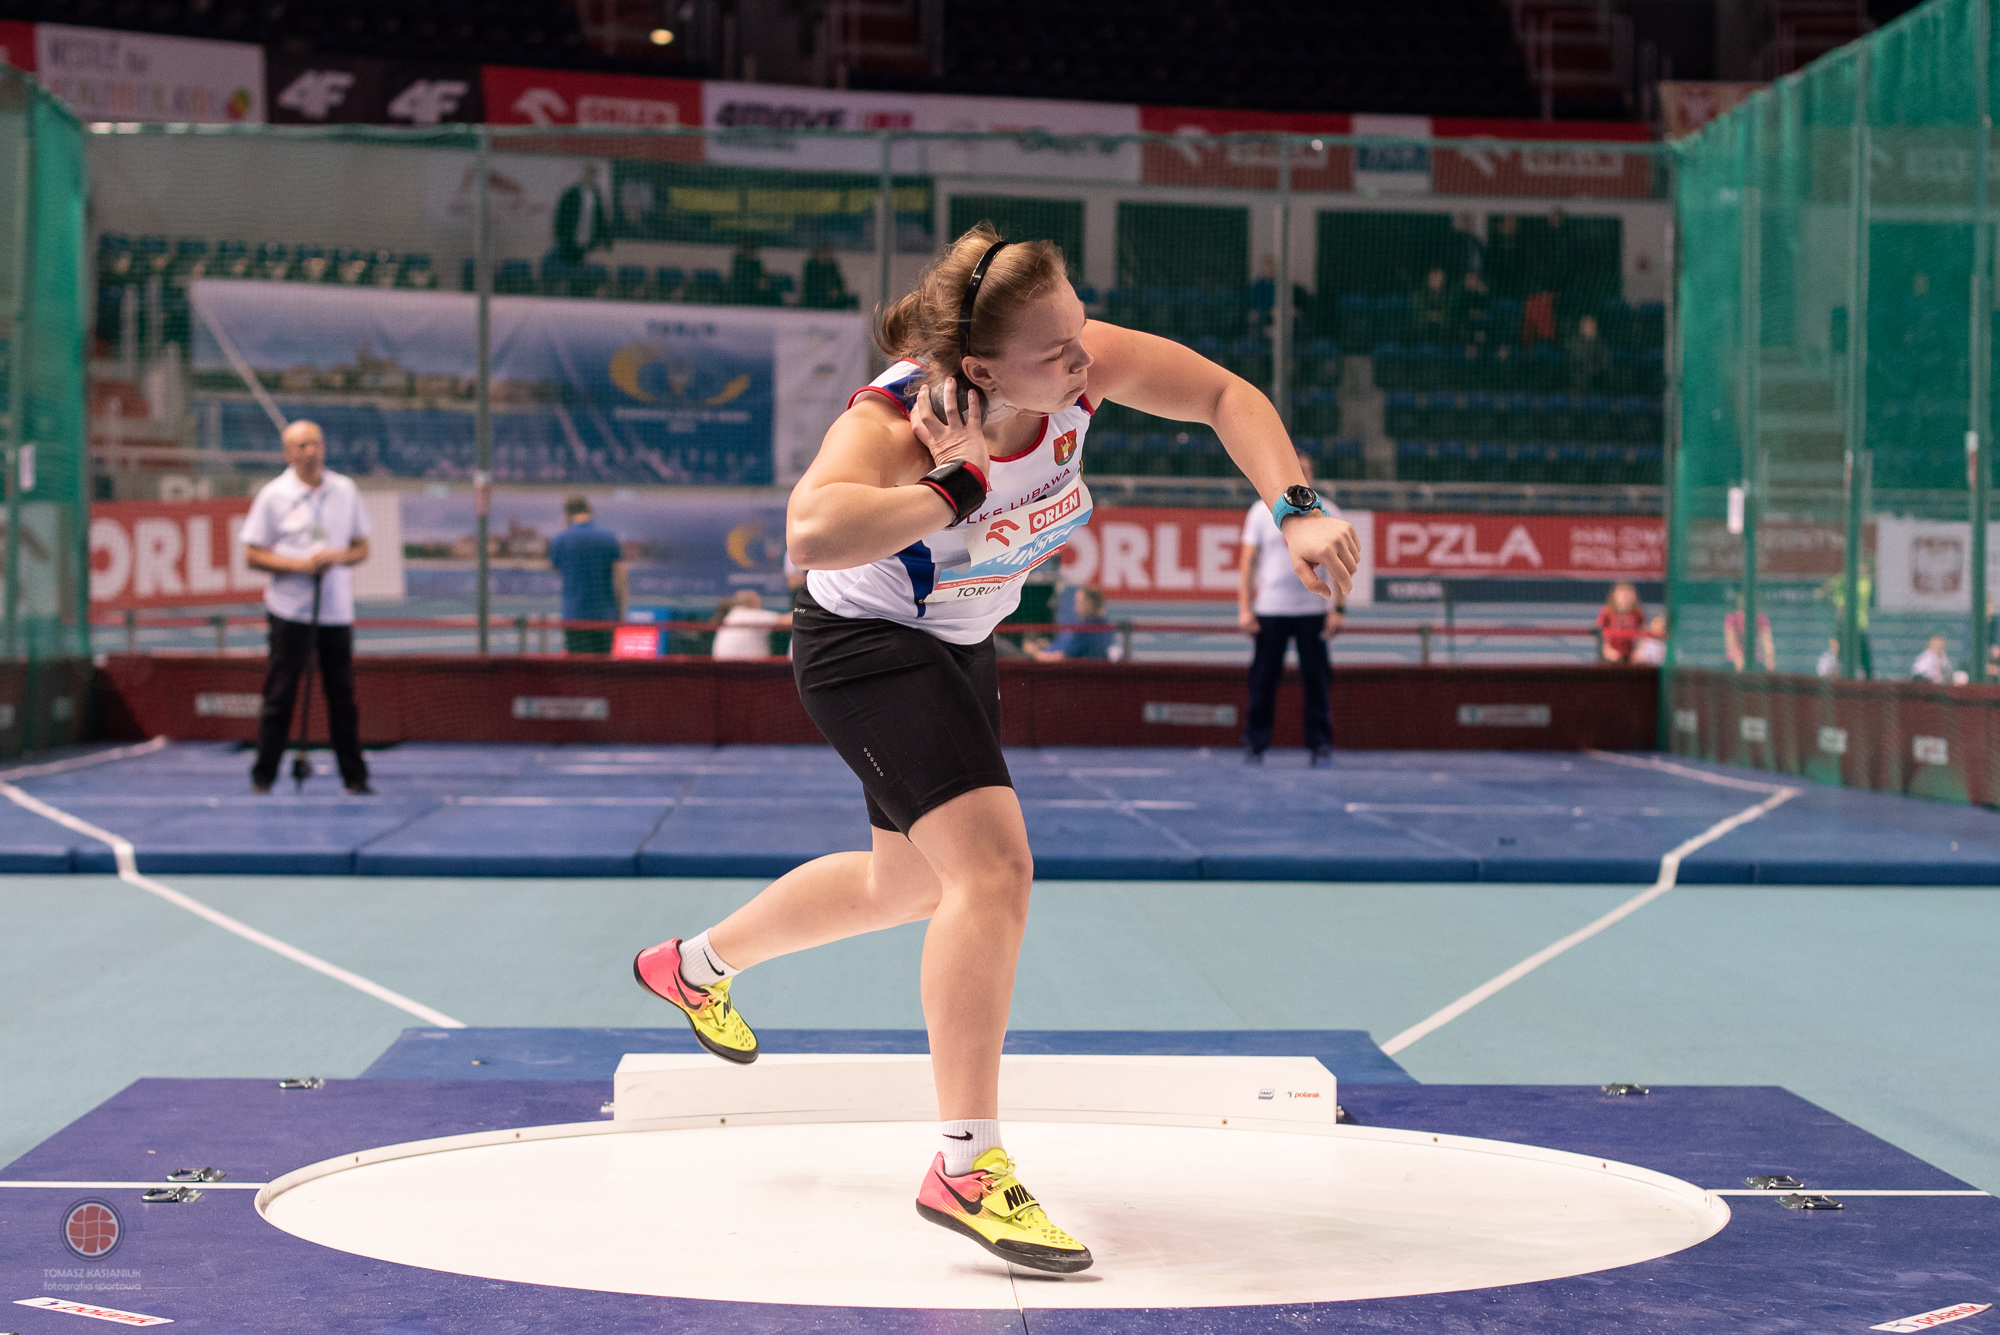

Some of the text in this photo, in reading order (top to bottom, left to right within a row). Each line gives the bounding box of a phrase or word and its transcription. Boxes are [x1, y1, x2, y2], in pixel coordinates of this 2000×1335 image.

[279, 69, 356, 119] 4F
[388, 79, 470, 124] 4F
[1010, 468, 1070, 510] LUBAWA
[1033, 491, 1078, 529] ORLEN
[89, 515, 269, 601] ORLE
[1061, 521, 1244, 590] ORLE
[1386, 522, 1542, 568] PZLA
[1003, 1184, 1036, 1211] NIK
[1912, 1305, 1981, 1325] polanik
